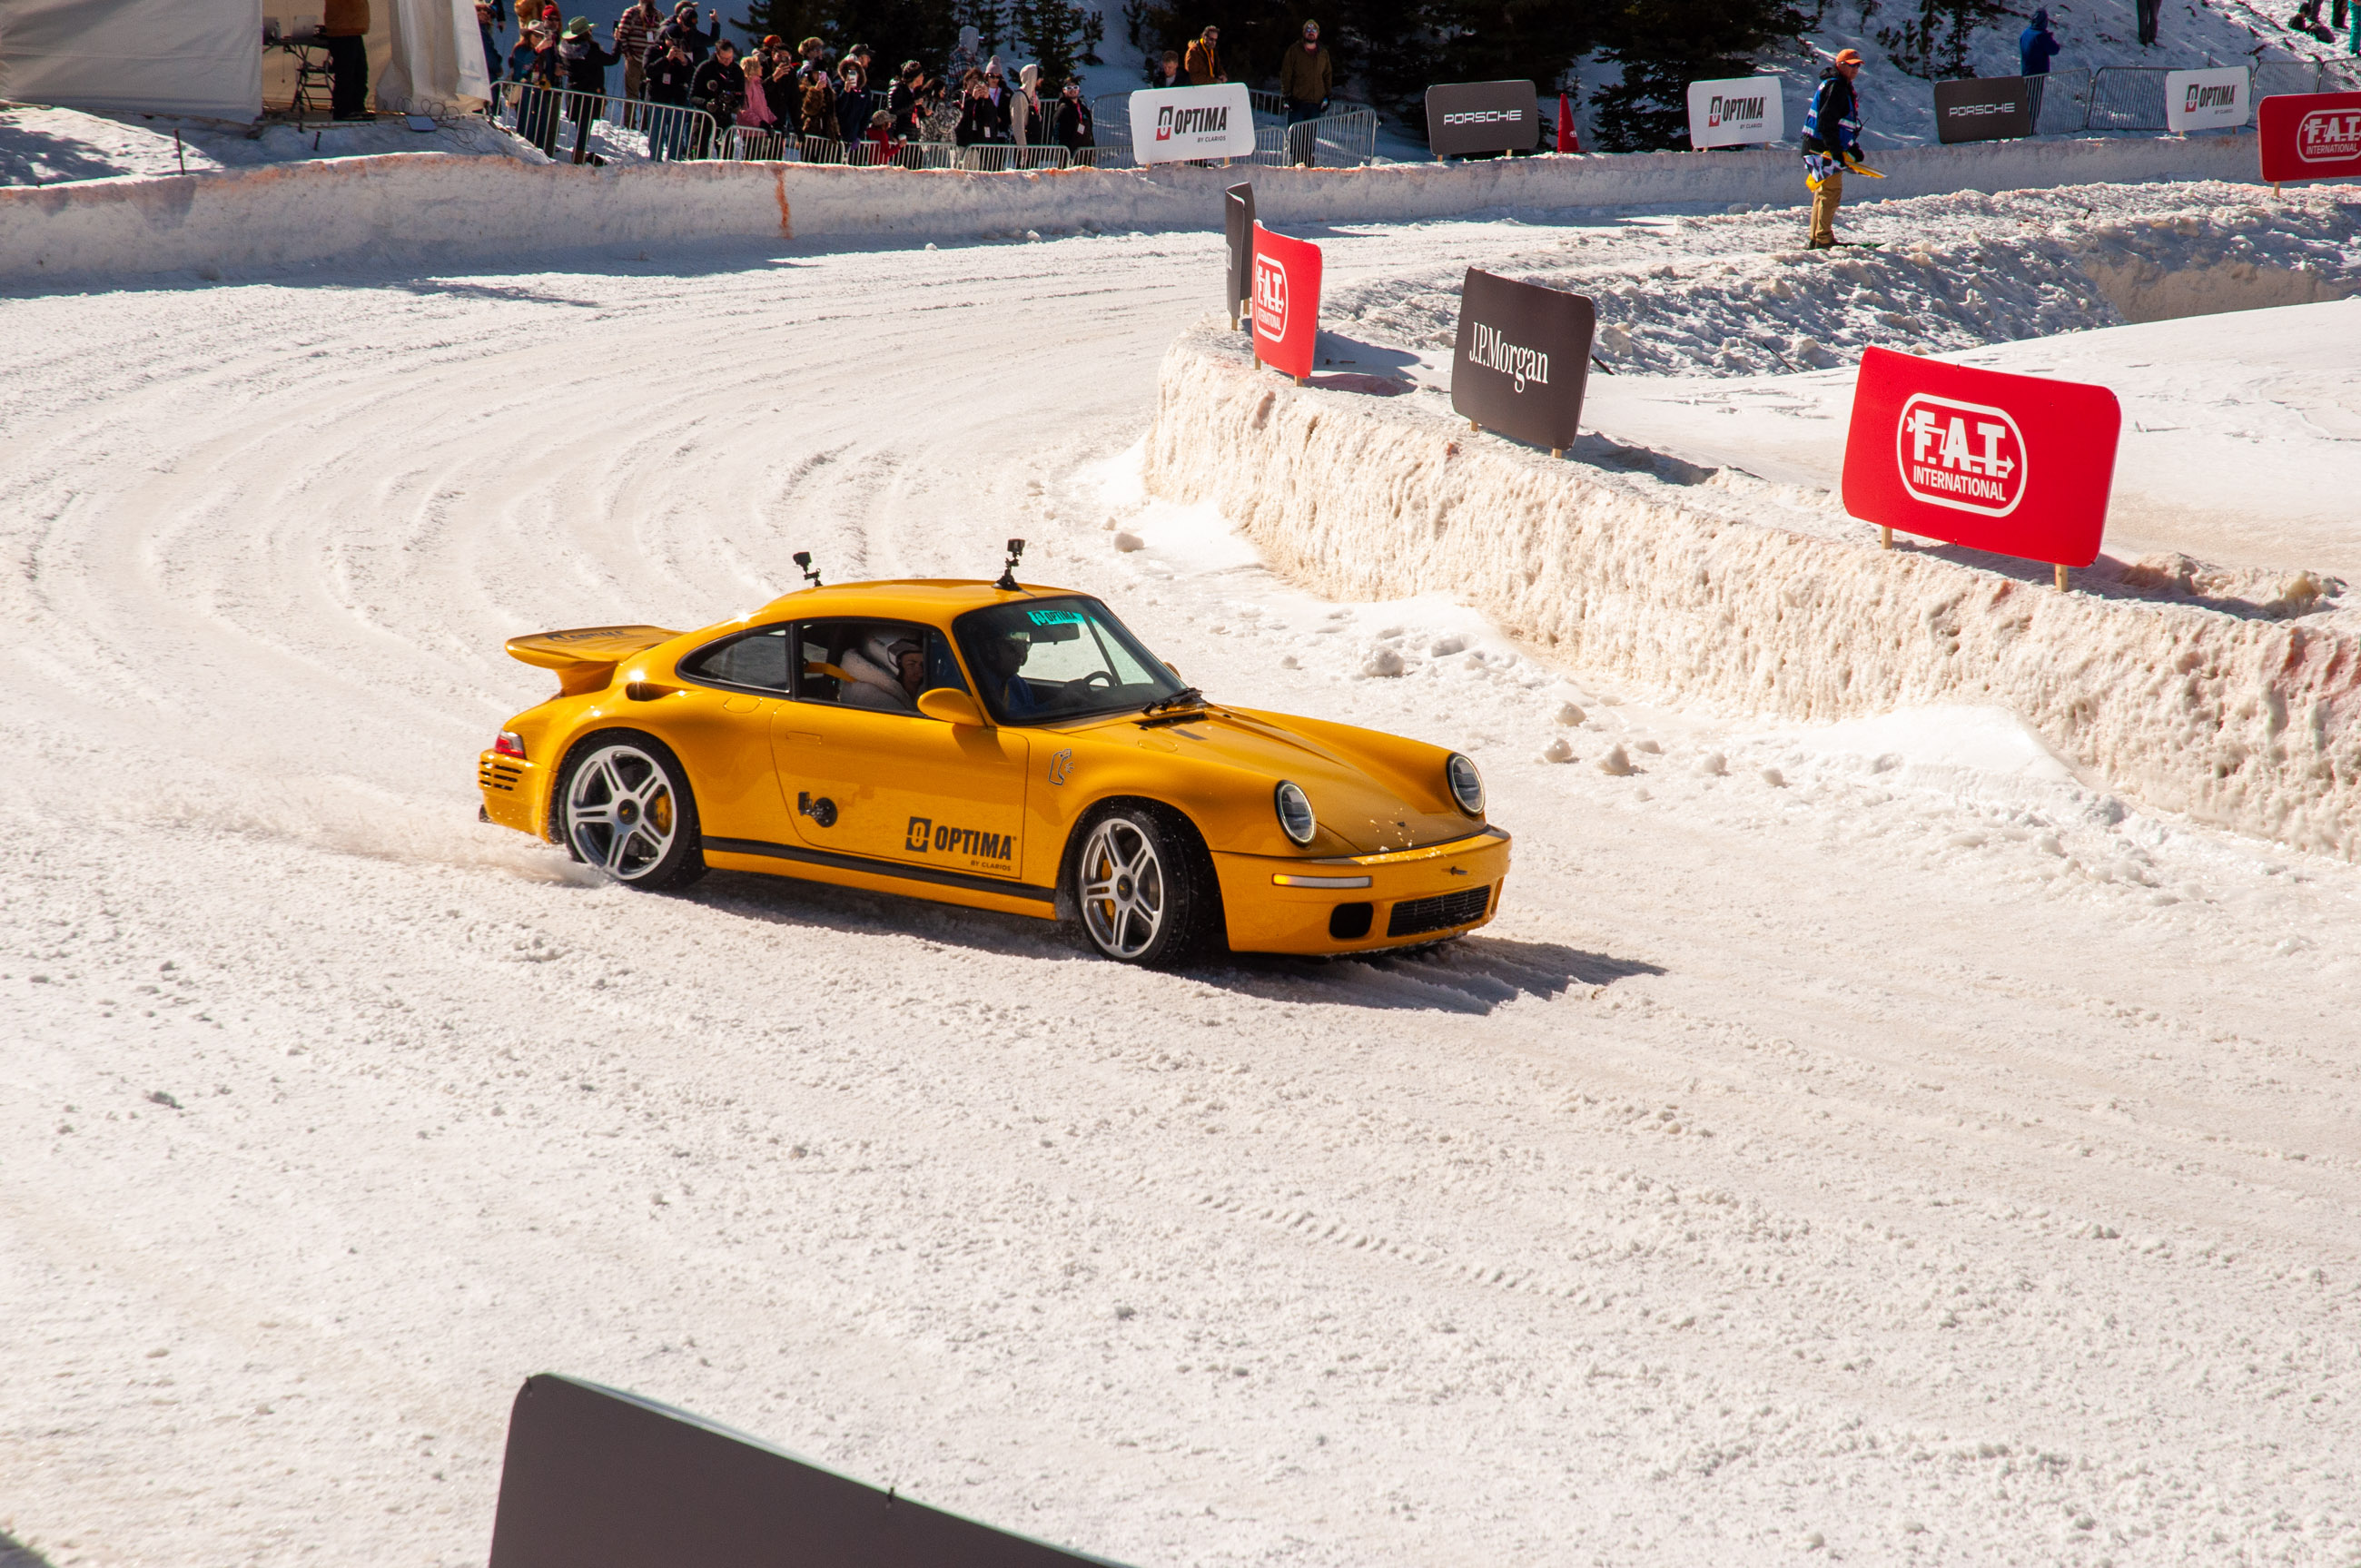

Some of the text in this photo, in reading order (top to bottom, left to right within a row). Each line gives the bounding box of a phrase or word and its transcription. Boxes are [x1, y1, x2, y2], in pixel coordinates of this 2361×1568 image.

[2199, 84, 2235, 107] OPTIMA
[1174, 106, 1228, 134] OPTIMA
[1443, 109, 1522, 125] PORSCHE
[1723, 96, 1764, 122] OPTIMA
[1949, 102, 2015, 117] PORSCHE
[2307, 143, 2358, 154] INTERNATIONAL
[1913, 409, 2009, 479] F.A.T.
[1913, 465, 2007, 502] INTERNATIONAL
[1045, 610, 1078, 622] OPTIMA
[934, 825, 1012, 861] OPTIMA
[982, 862, 1012, 872] CLARIOS
